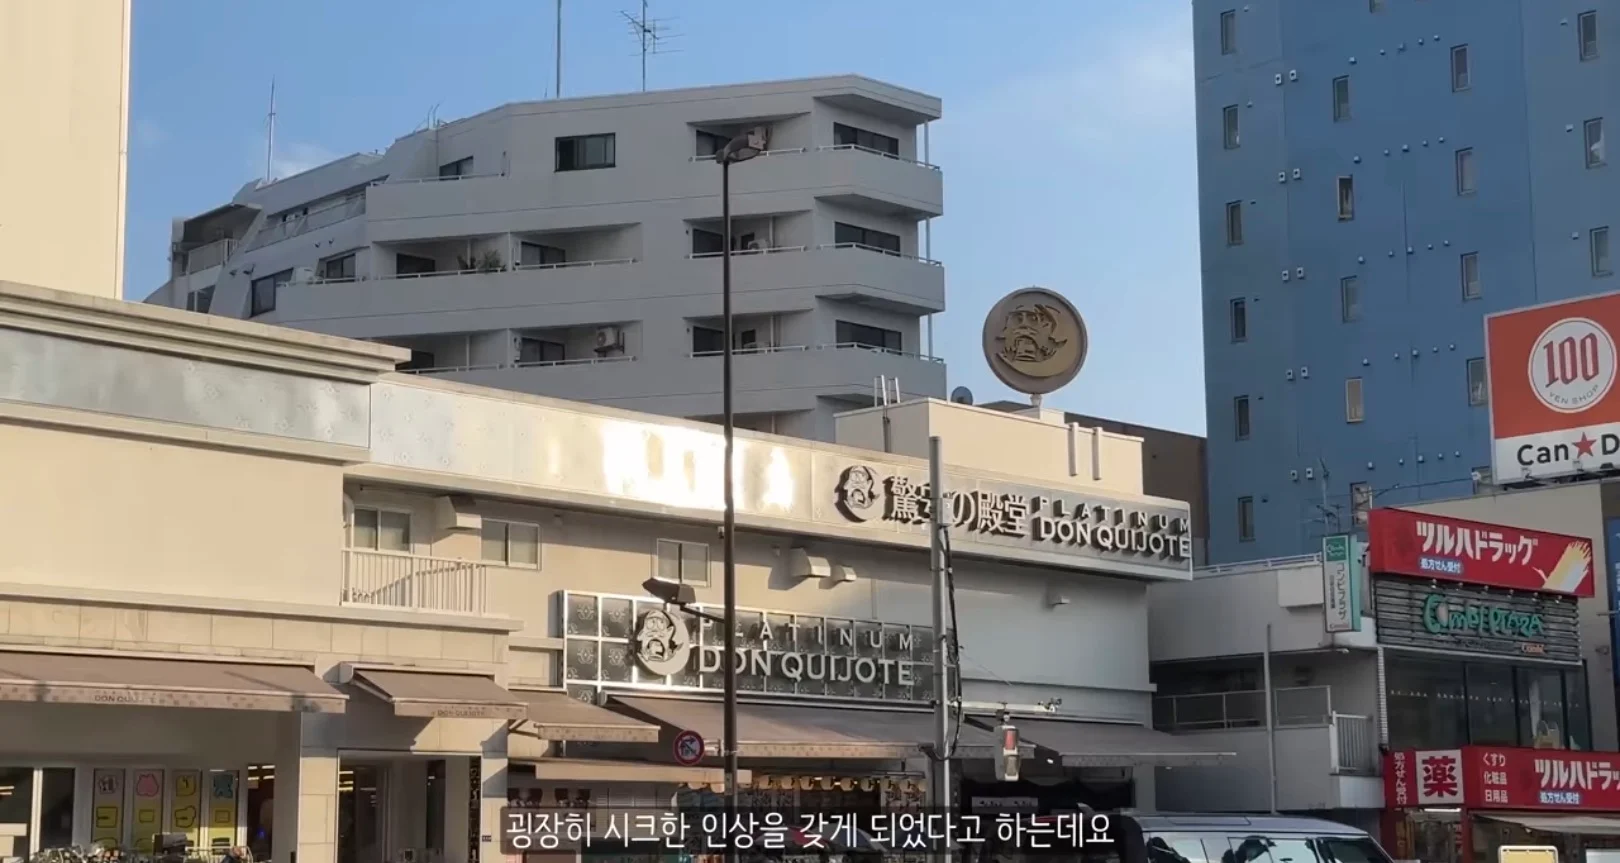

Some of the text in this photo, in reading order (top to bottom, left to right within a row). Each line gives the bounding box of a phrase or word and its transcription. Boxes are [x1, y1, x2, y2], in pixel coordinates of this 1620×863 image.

[1543, 332, 1600, 389] 100
[1549, 384, 1599, 405] YEN SHOP
[1516, 443, 1569, 467] Can
[1039, 496, 1190, 533] PLATINUM
[1041, 516, 1192, 558] DON QUIJOTE
[1416, 521, 1539, 566] ツルハドラッグ
[780, 651, 915, 687] QUIJOTE
[1421, 755, 1459, 798] 薬
[1483, 753, 1506, 767] くすり
[1484, 771, 1508, 785] 化粧品
[1485, 789, 1509, 803] 日用品
